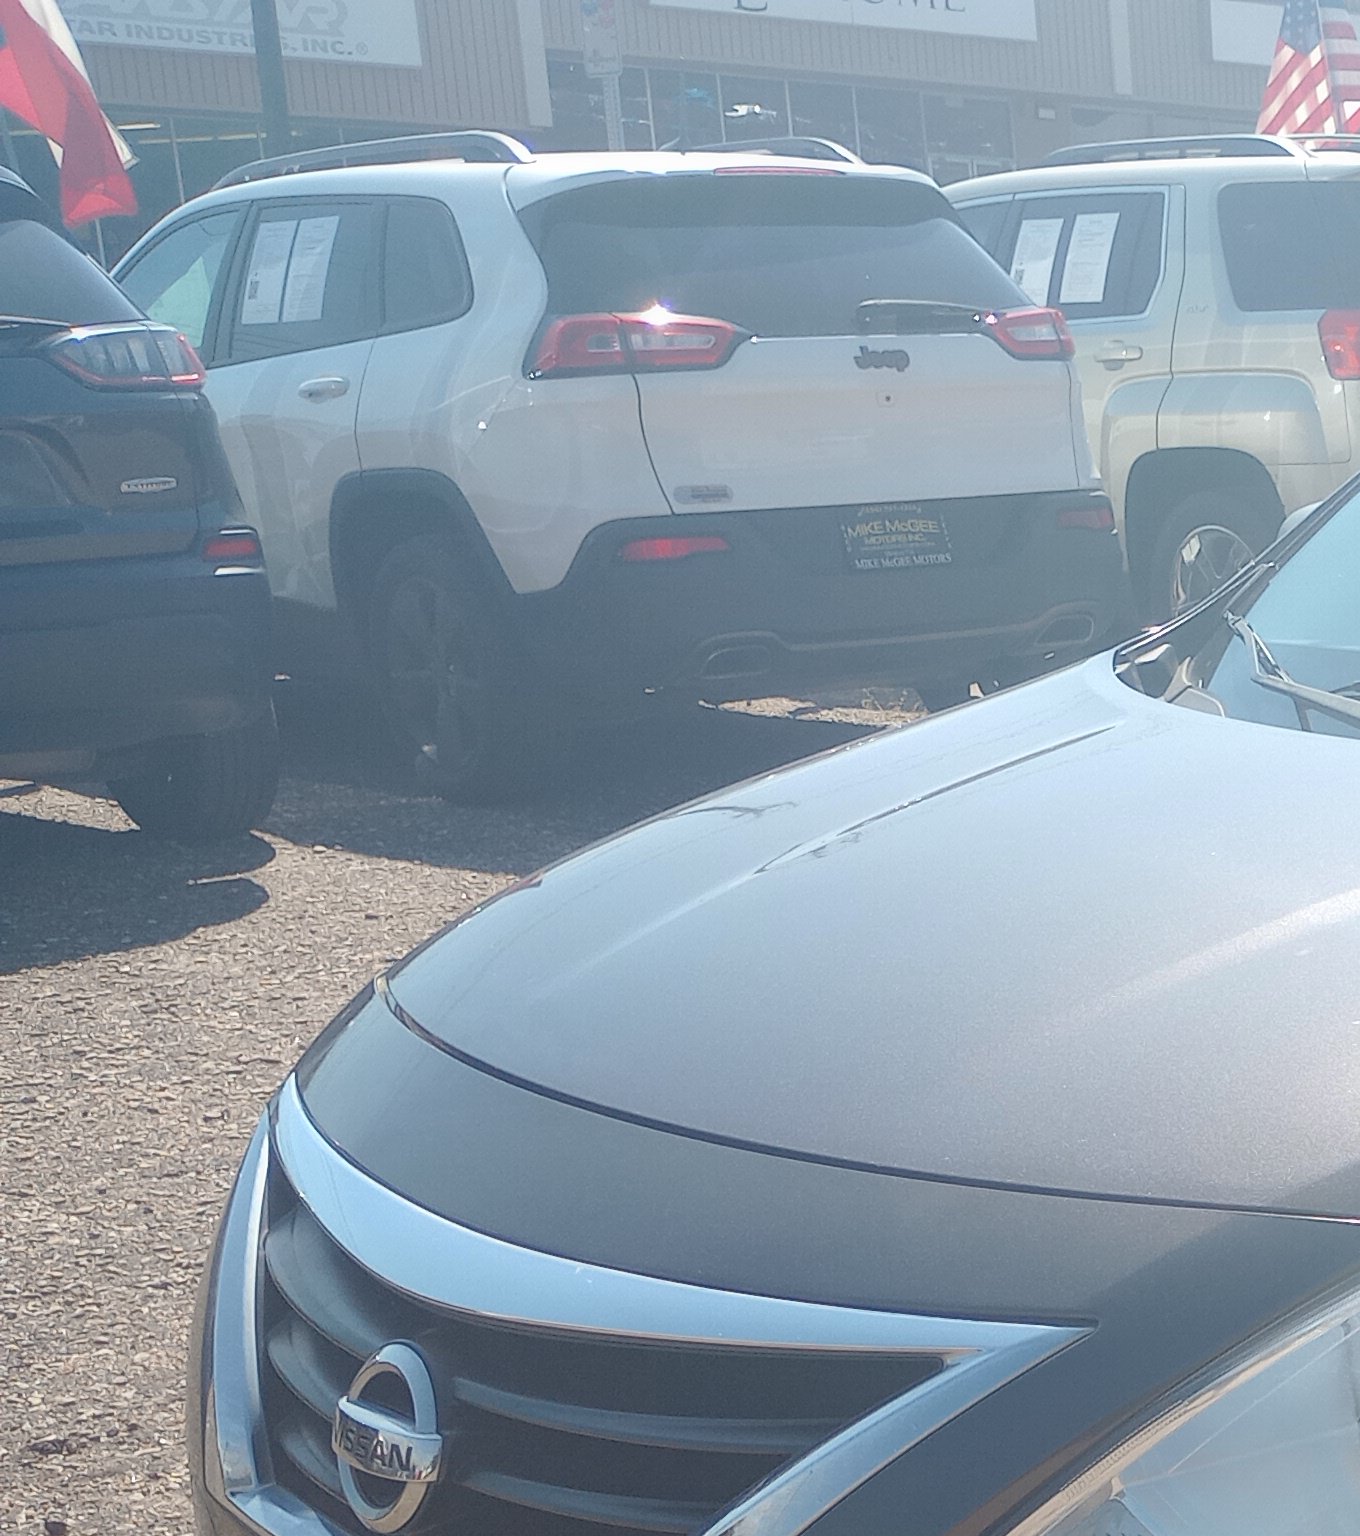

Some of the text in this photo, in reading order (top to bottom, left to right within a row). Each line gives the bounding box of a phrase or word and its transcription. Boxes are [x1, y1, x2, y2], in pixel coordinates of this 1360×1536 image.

[853, 345, 910, 373] Jeep
[847, 518, 940, 537] MIKE McGEE
[855, 558, 881, 570] MIKE
[913, 552, 952, 565] MOTORS
